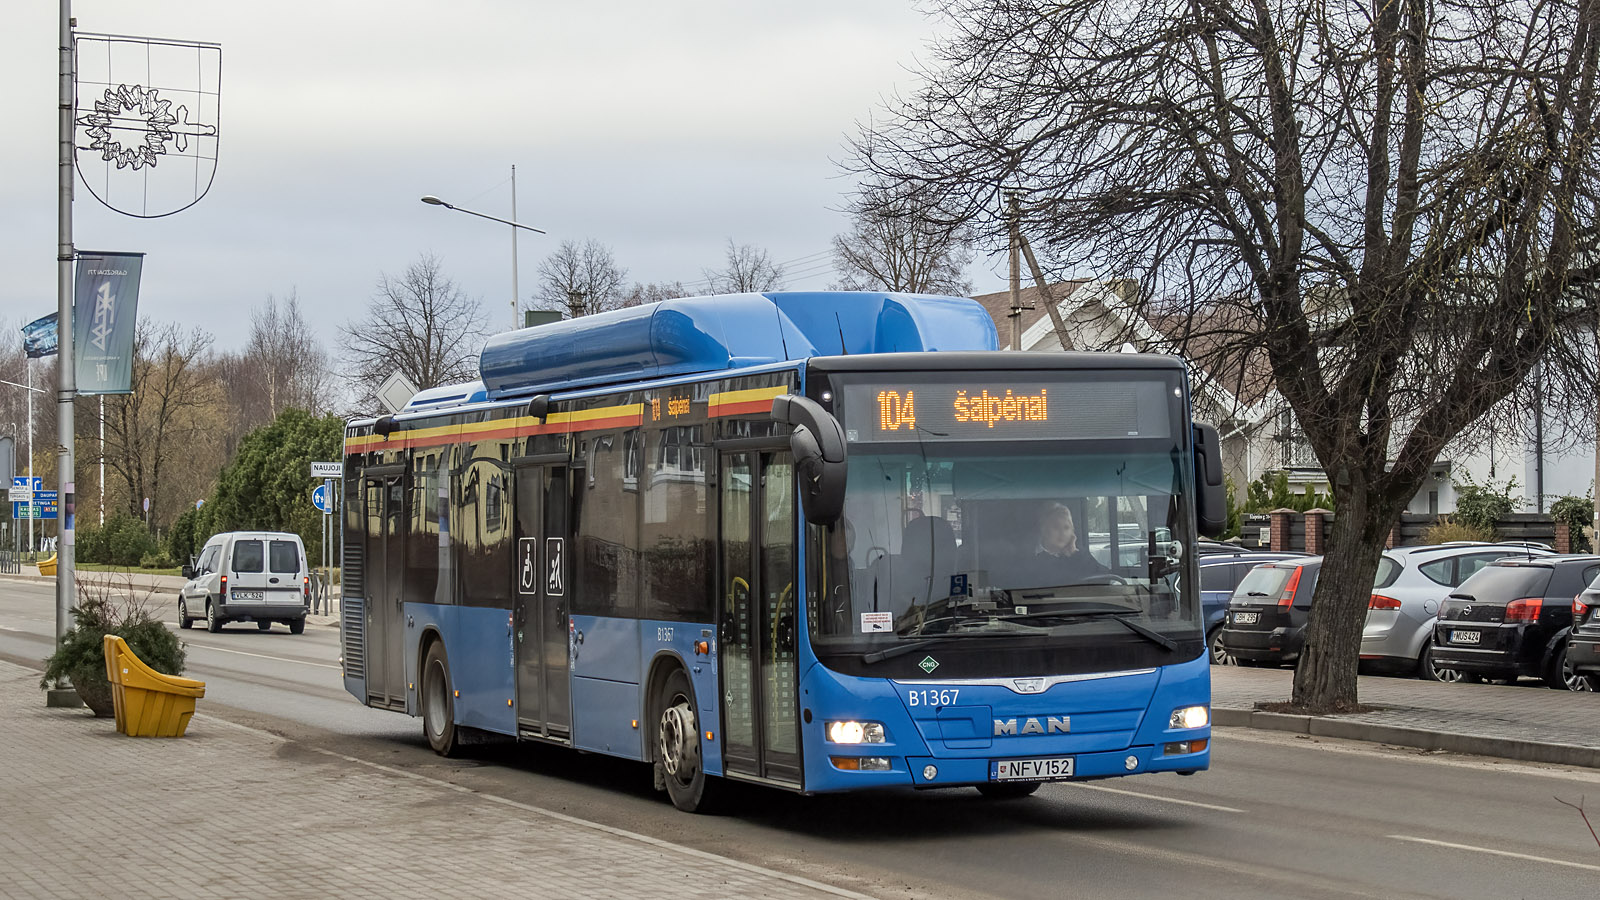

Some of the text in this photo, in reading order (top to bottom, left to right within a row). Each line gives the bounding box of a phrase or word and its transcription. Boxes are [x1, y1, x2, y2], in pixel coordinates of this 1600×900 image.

[877, 388, 1048, 430] 104 šalpėnai
[657, 627, 674, 641] B1367
[909, 689, 960, 706] B1367
[993, 716, 1071, 736] MAN
